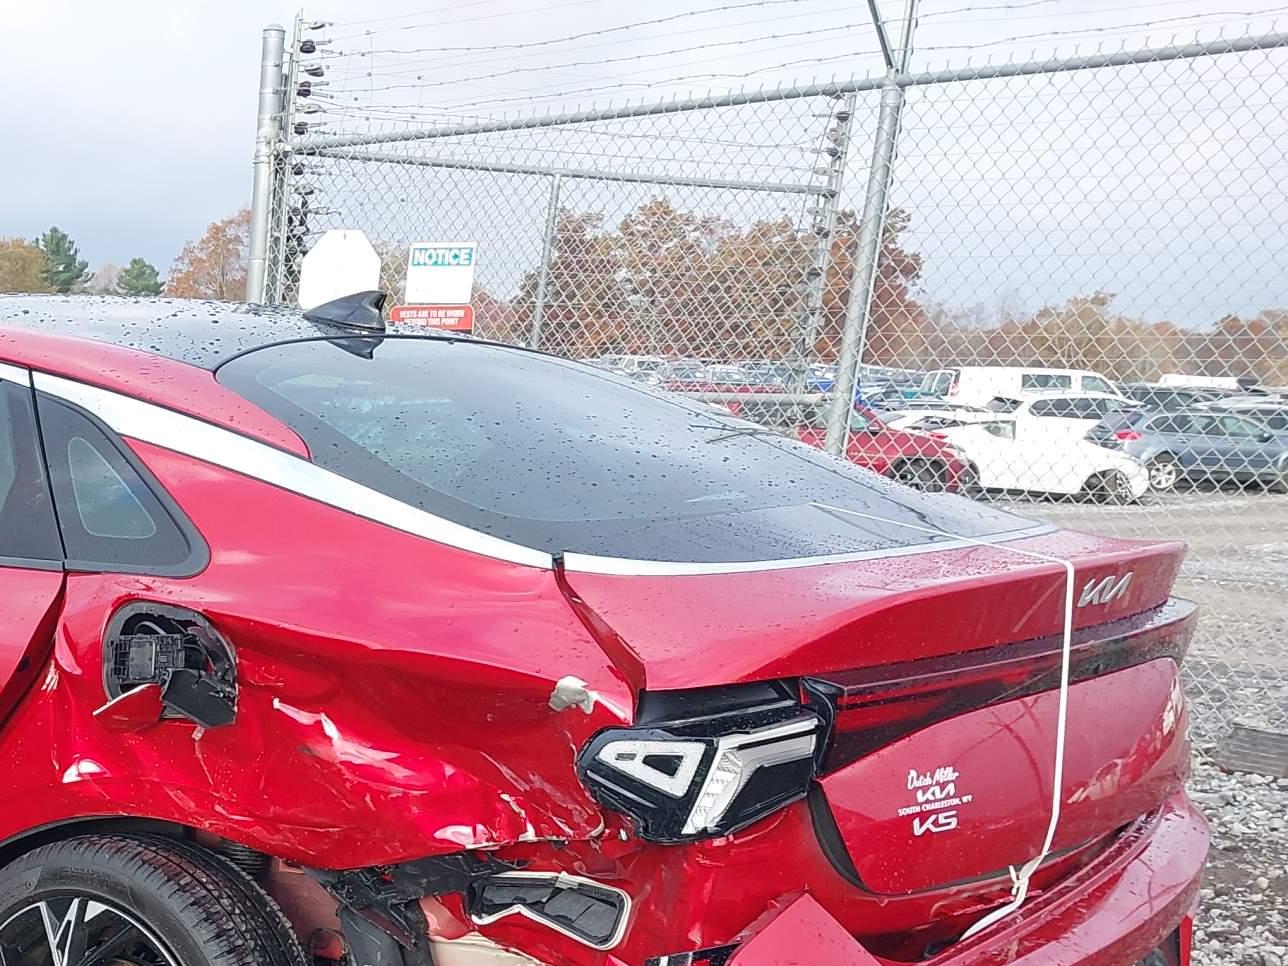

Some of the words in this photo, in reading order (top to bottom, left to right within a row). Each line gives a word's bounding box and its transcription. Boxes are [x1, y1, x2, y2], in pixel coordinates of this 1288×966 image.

[413, 248, 471, 265] NOTICE
[1077, 572, 1134, 608] KIA
[913, 810, 958, 836] K5
